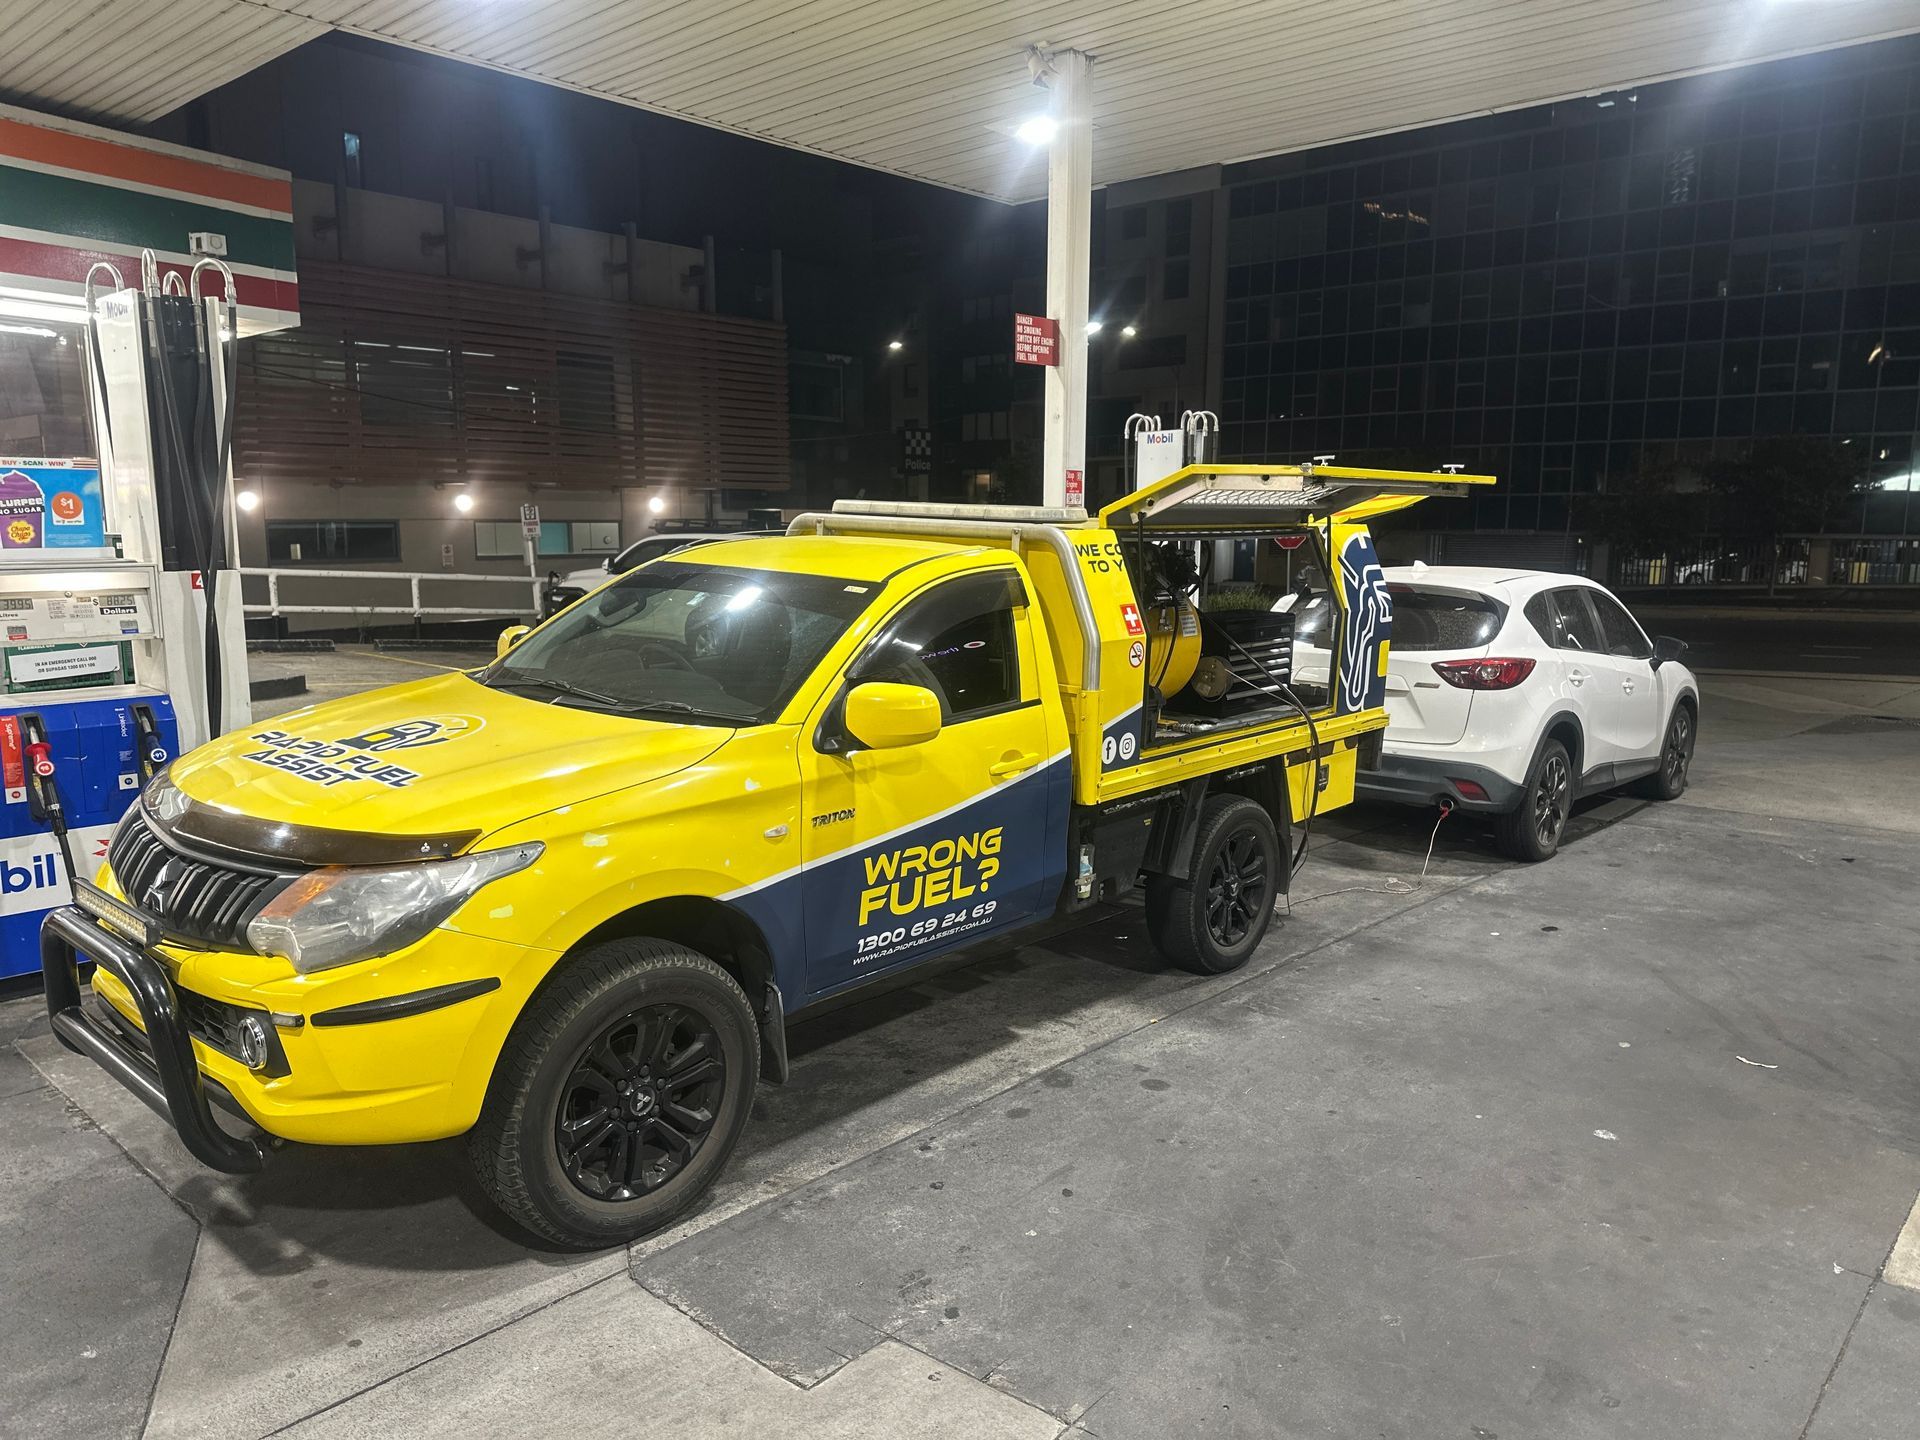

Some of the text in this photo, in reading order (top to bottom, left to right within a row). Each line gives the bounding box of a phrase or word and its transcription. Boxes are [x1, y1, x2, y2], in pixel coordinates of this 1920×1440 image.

[1016, 316, 1032, 325] DANGER
[1016, 324, 1042, 336] NO SMOKING
[1016, 334, 1032, 344] SWITCH
[1041, 337, 1054, 346] ENGINE
[1016, 343, 1049, 354] BEFORE OPENING
[1016, 352, 1038, 361] FUEL TANK
[1146, 433, 1174, 444] Mobil
[905, 458, 931, 470] Police
[60, 497, 74, 510] $1
[1075, 544, 1100, 557] WE
[1088, 560, 1110, 573] TO
[118, 713, 129, 737] Unleaded
[250, 731, 420, 788] RAPID FUEL
[241, 750, 363, 786] ASSIST
[811, 808, 856, 828] TRITON
[864, 826, 1004, 886] WRONG
[858, 858, 1000, 926] FUEL?
[857, 900, 997, 954] 1300 69 24 69
[852, 916, 992, 966] WWW.RAPIDFUELASSIST.COM.AU
